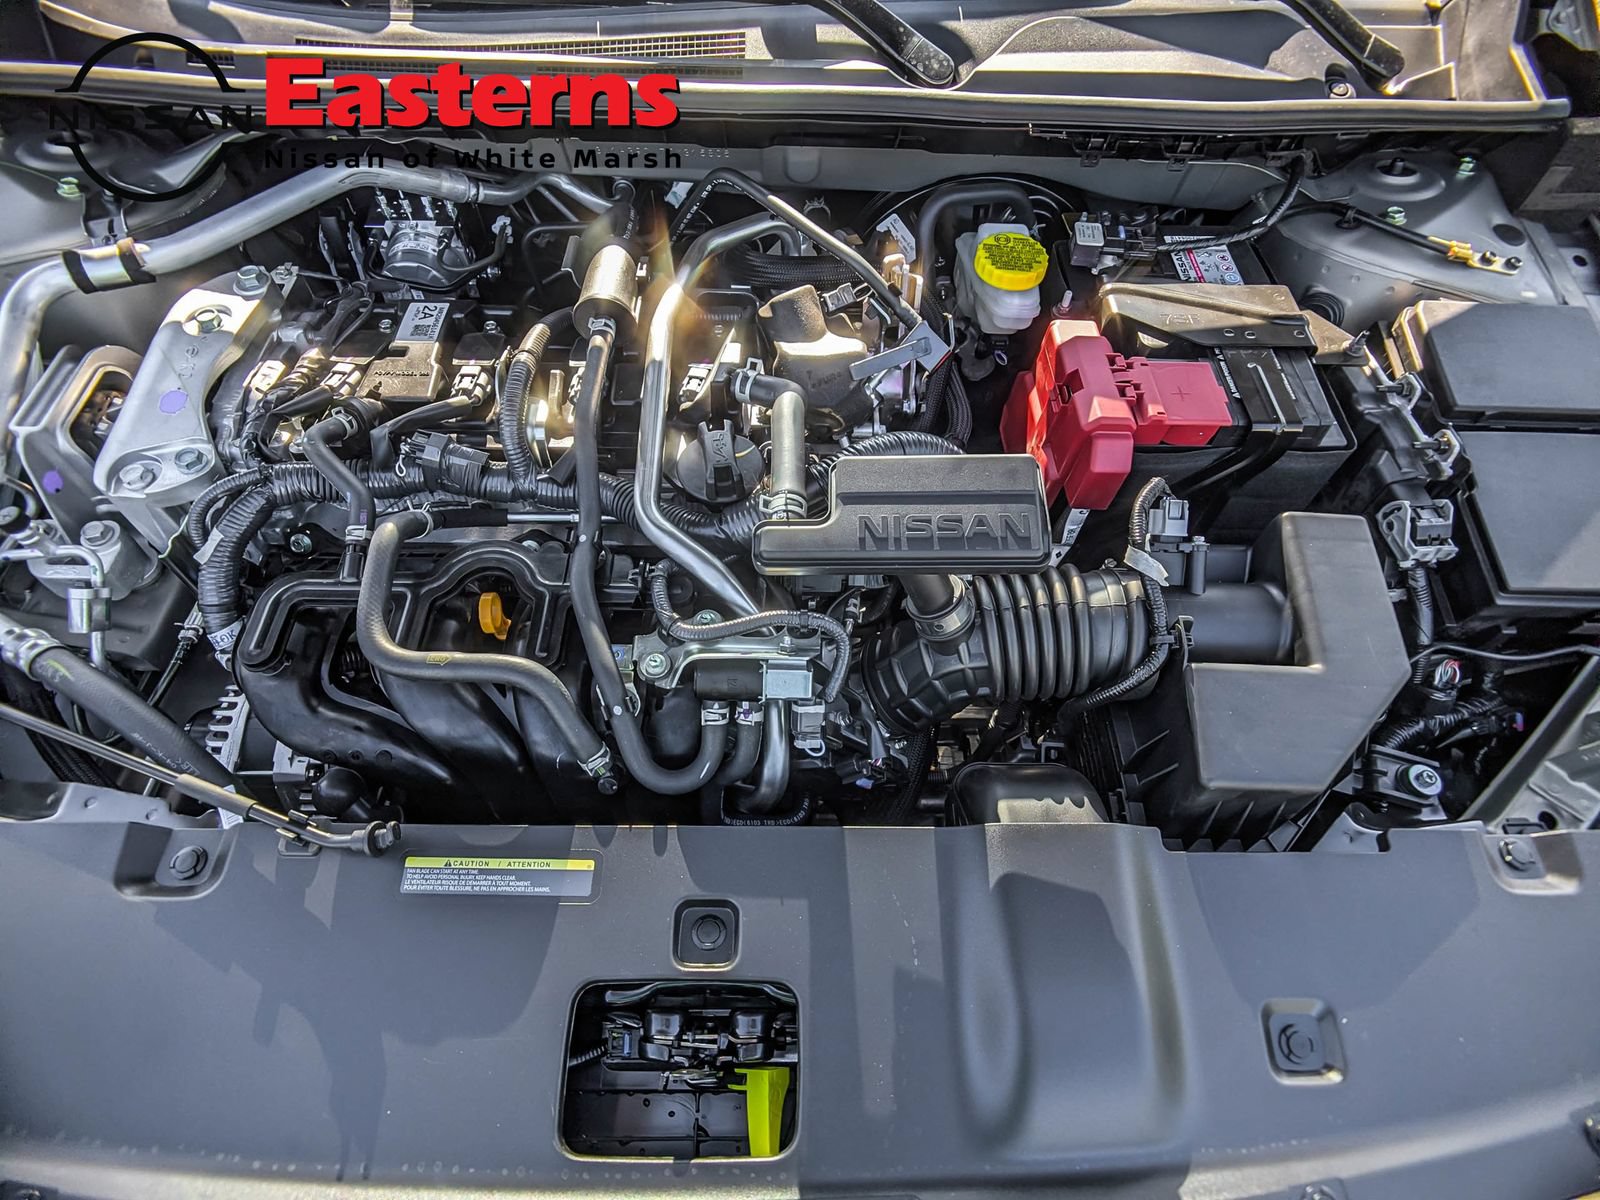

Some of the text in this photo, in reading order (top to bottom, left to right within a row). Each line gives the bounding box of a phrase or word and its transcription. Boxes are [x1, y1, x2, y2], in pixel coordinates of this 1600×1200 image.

[418, 305, 438, 320] 2A
[858, 512, 1032, 543] NISSAN
[507, 860, 551, 868] ATTENTION
